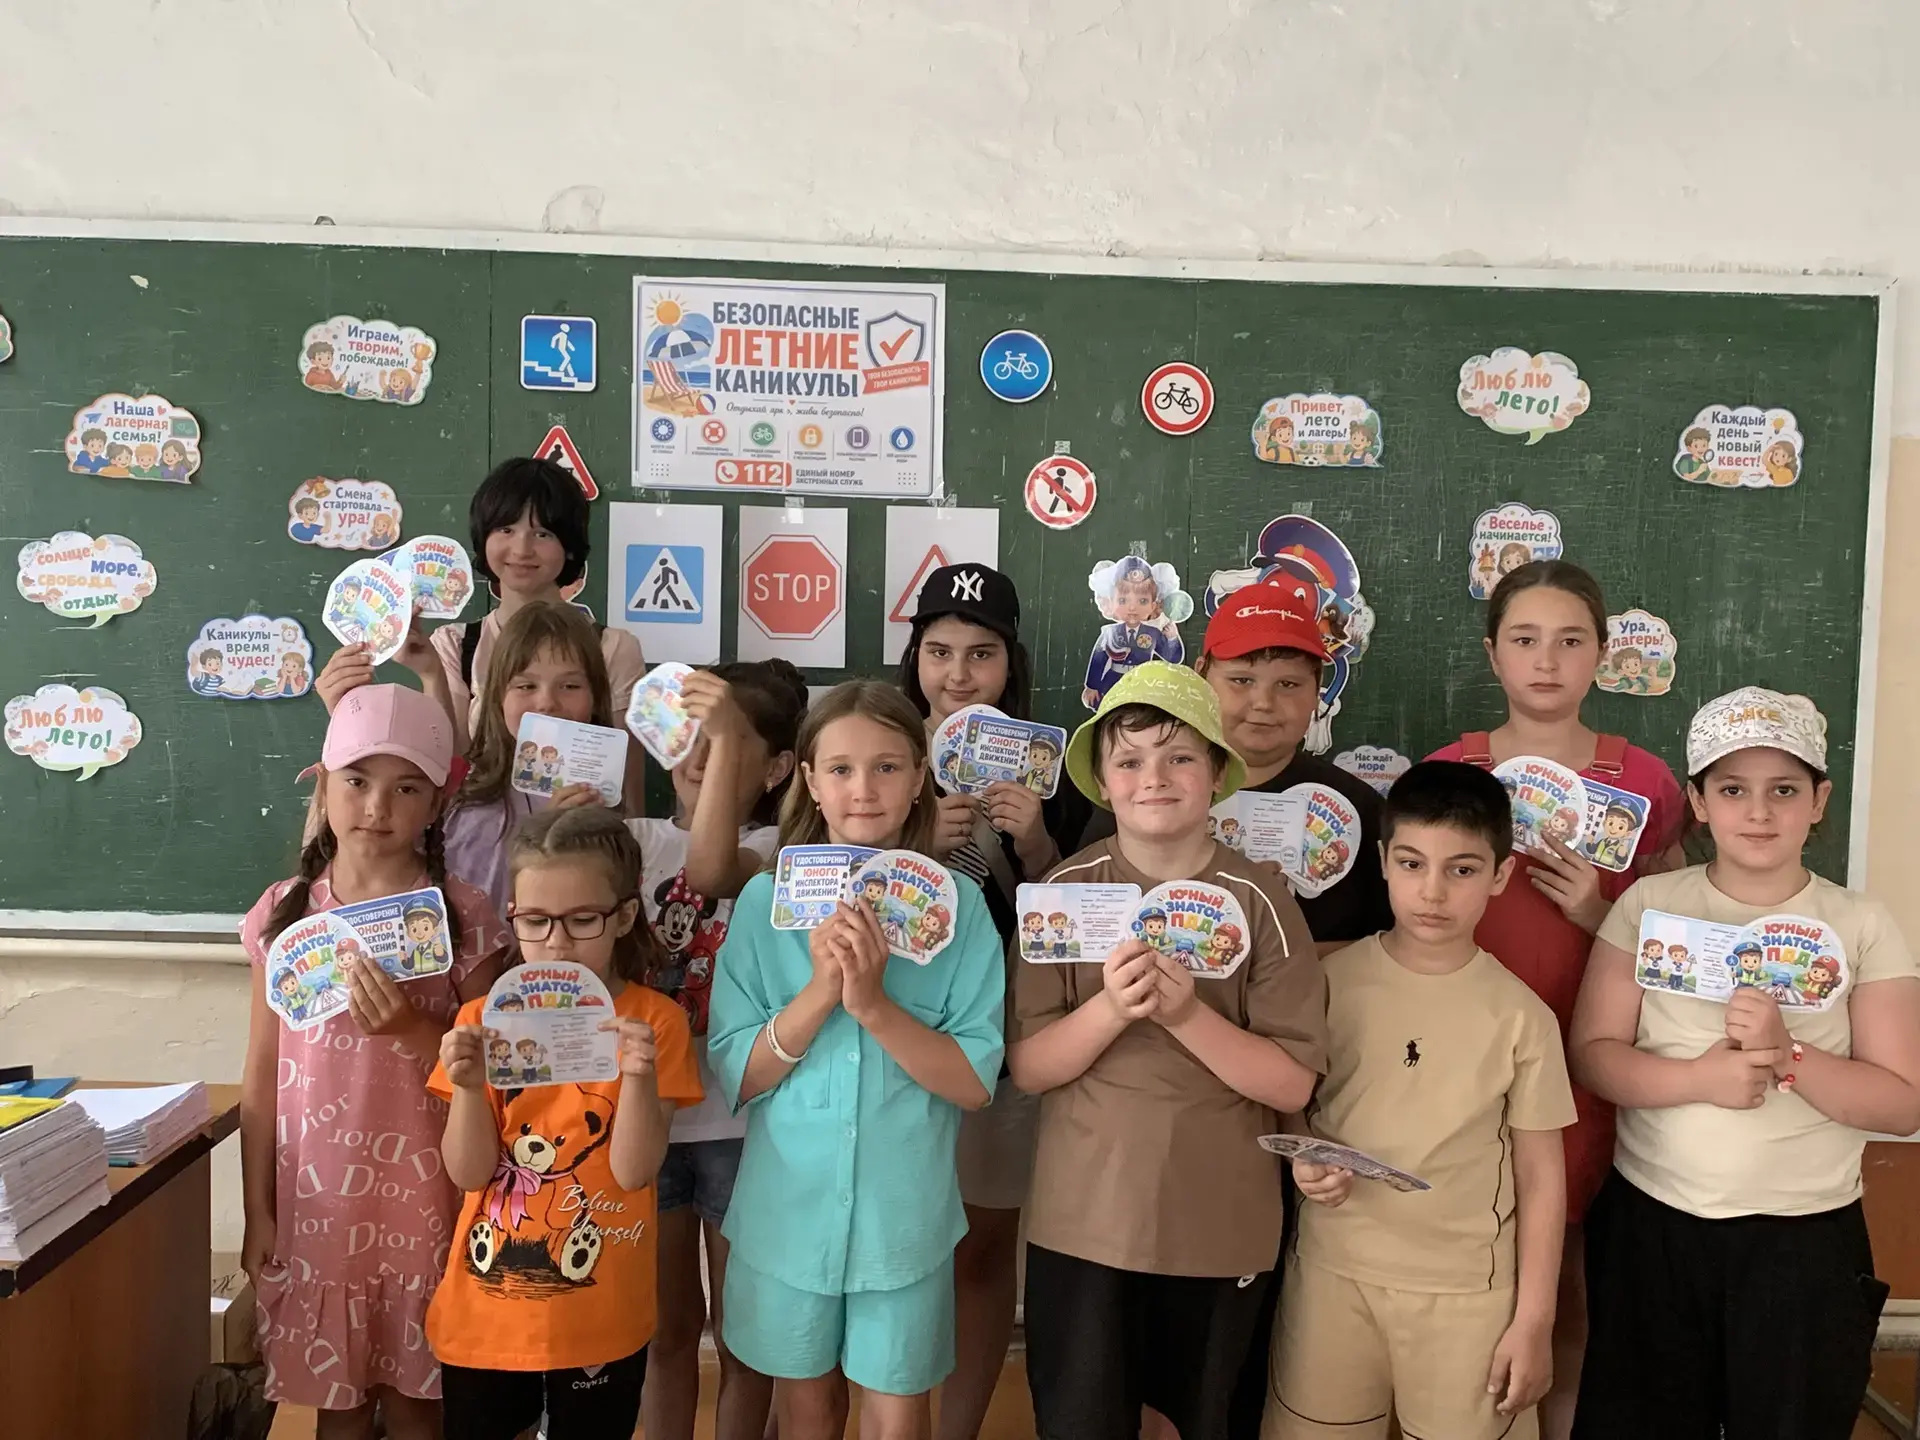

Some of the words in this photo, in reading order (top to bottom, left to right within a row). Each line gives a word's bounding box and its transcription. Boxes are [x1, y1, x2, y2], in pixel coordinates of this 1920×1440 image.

[713, 301, 860, 330] БЕЗОПАСНЫЕ
[348, 325, 404, 345] Играем,
[348, 340, 404, 357] творим,
[715, 328, 860, 370] ЛЕТНИЕ
[339, 353, 409, 369] побеждаем!
[715, 368, 859, 398] КАНИКУЛЫ
[114, 401, 154, 417] Наша
[726, 402, 768, 417] Отдыхай
[796, 408, 818, 416] живи
[821, 407, 865, 419] безопасно!
[1290, 399, 1346, 415] Привет,
[1494, 390, 1560, 420] лето!
[104, 416, 169, 431] лагерная
[1304, 415, 1341, 427] лето
[1711, 411, 1767, 427] Каждый
[112, 431, 162, 444] семья!
[1298, 430, 1305, 438] и
[1307, 428, 1348, 440] лагерь!
[1717, 427, 1750, 440] день
[1717, 440, 1762, 453] новый
[1718, 455, 1762, 468] квест!
[743, 463, 783, 484] 112
[795, 467, 828, 479] ЕДИНЫЙ
[829, 468, 856, 479] НОМЕР
[840, 478, 864, 487] СЛУЖБ
[335, 486, 373, 501] Смена
[323, 501, 382, 513] стартовала
[338, 512, 371, 529] ура!
[1489, 515, 1545, 532] Веселье
[1479, 530, 1553, 543] начинается!
[414, 541, 456, 557] ЮНЫЙ
[412, 552, 455, 568] ЗНАТОК
[369, 566, 407, 599] ЮНЫЙ
[753, 572, 832, 604] STOP
[950, 569, 985, 602] NY
[363, 575, 400, 611] ЗНАТОК
[206, 628, 271, 642] Каникулы
[1619, 620, 1650, 635] Ура,
[226, 642, 270, 656] время
[1611, 633, 1665, 651] лагерь!
[227, 654, 277, 670] чудес!
[45, 726, 113, 753] лето!
[981, 723, 1029, 740] УДОСТОВЕРЕНИЕ
[988, 735, 1021, 749] ЮНОГО
[979, 743, 1020, 758] ИНСПЕКТОРА
[1354, 752, 1371, 762] Нас
[1372, 753, 1394, 763] ждёт
[978, 752, 1019, 767] ДВИЖЕНИЯ
[1358, 762, 1386, 772] море
[1525, 763, 1574, 792] ЮНЫЙ
[1518, 773, 1570, 805] ЗНАТОК
[1311, 790, 1353, 826] ЮНЫЙ
[794, 854, 848, 867] УДОСТОВЕРЕНИЕ
[803, 867, 839, 878] ЮНОГО
[895, 857, 946, 889] ЮНЫЙ
[794, 876, 839, 888] ИНСПЕКТОРА
[888, 867, 942, 902] ЗНАТОК
[794, 887, 838, 899] ДВИЖЕНИЯ
[1168, 888, 1226, 909] ЮНЫЙ
[346, 906, 399, 926] ДОСТОВЕРЕНИЕ
[1164, 900, 1225, 923] ЗНАТОК
[281, 919, 329, 953] ЮНЫЙ
[1764, 922, 1824, 942] ЮНЫЙ
[284, 933, 336, 966] ЗНАТОК
[1760, 934, 1823, 955] ЗНАТОК
[519, 968, 580, 983] ЮНЫЙ
[518, 981, 583, 996] ЗНАТОК
[335, 1163, 416, 1202] Dior
[558, 1184, 628, 1213] Believe
[570, 1210, 645, 1248] Yourself
[343, 1220, 422, 1258] Dior
[571, 1374, 610, 1390] CONNIE
